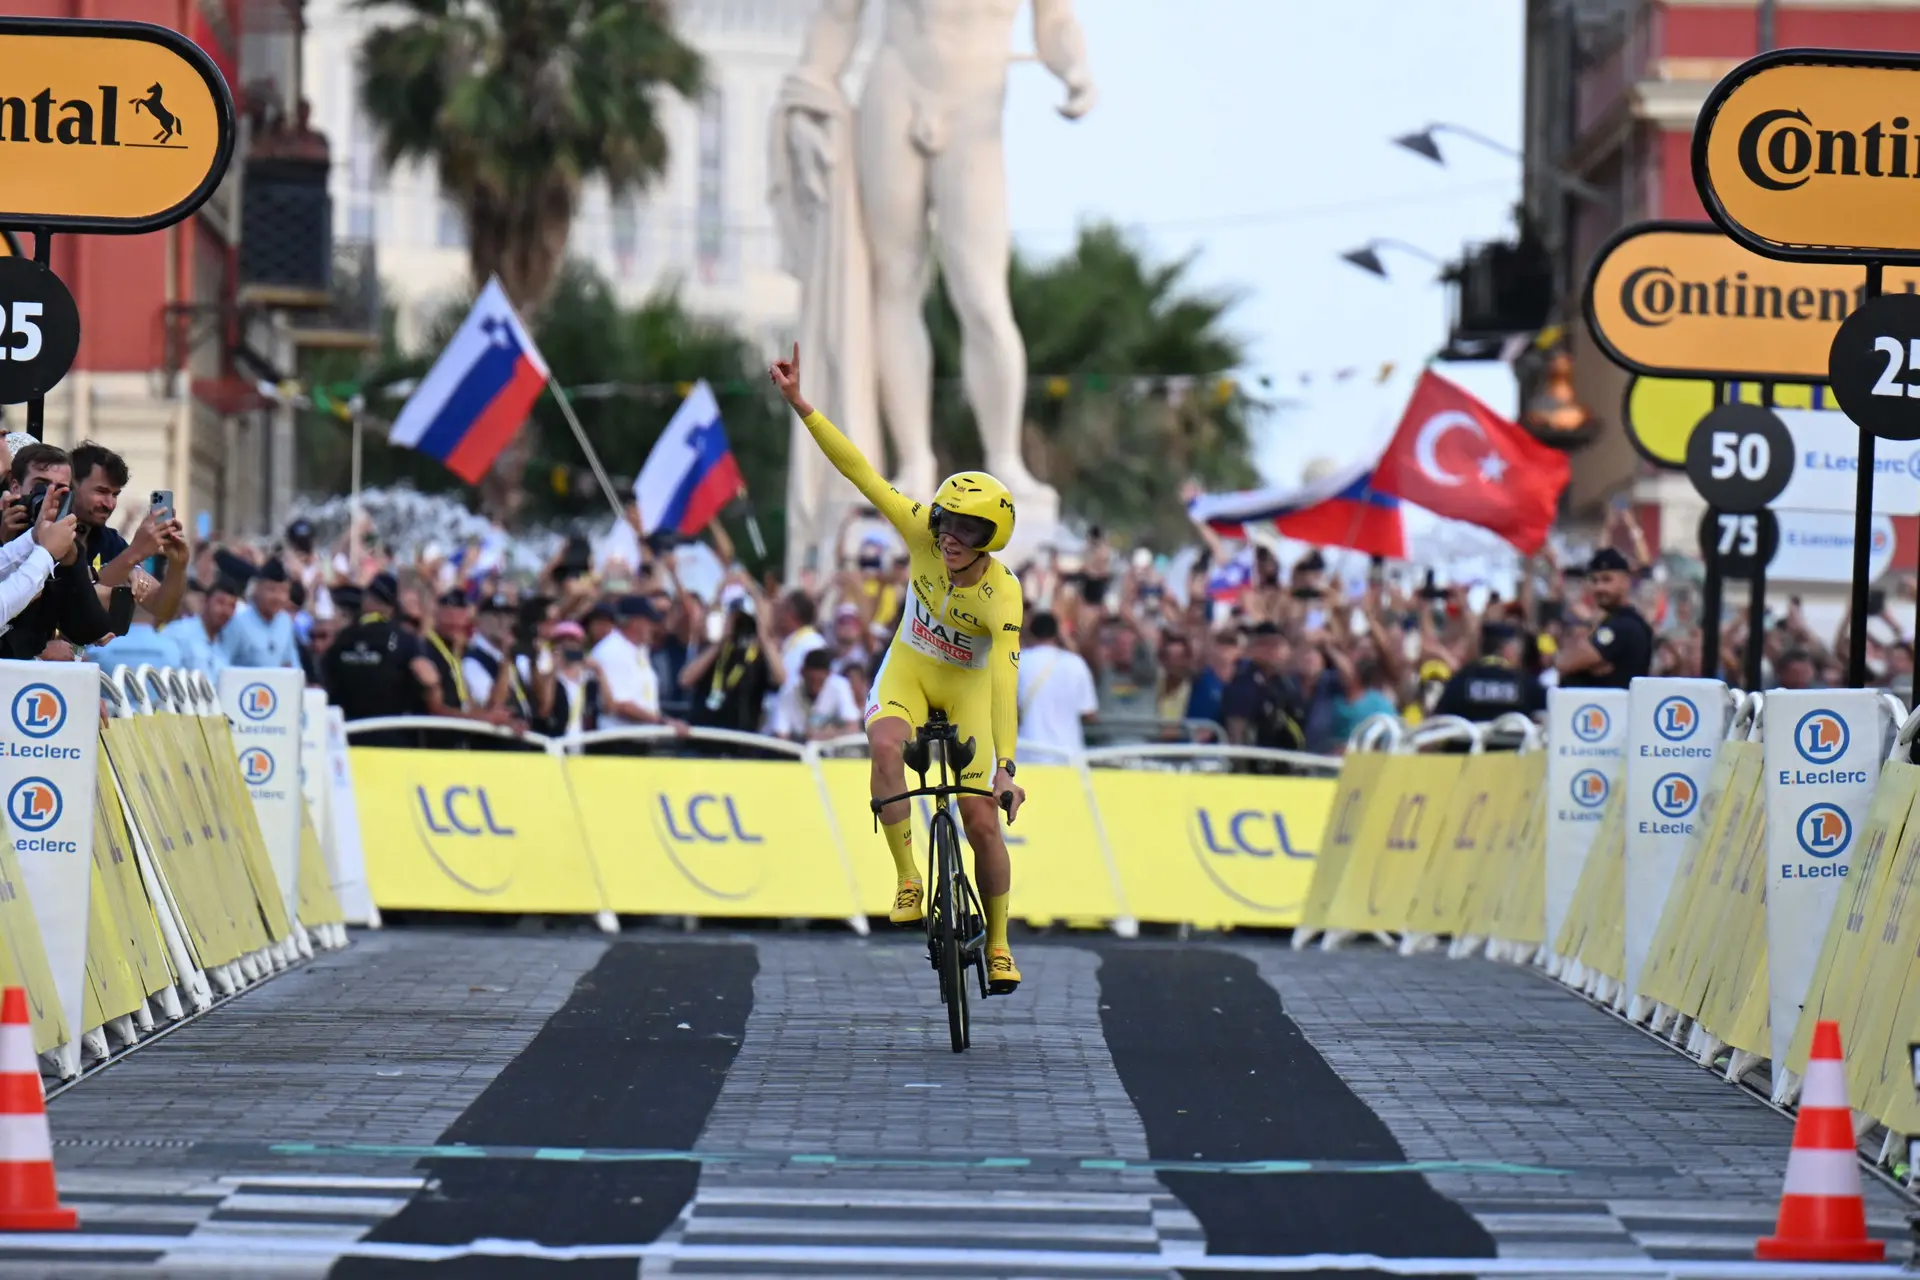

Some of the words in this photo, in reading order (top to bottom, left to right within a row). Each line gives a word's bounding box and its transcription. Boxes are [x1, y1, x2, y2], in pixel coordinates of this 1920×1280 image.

[1738, 107, 1920, 191] Conti
[0, 301, 43, 362] 5
[1711, 431, 1770, 480] 50
[1805, 452, 1905, 473] E.Lecerc
[1717, 514, 1759, 556] 75
[916, 599, 972, 650] UAE
[953, 608, 982, 628] LCL
[913, 621, 971, 660] Emirates
[1640, 744, 1711, 758] E.Leclerc
[961, 771, 983, 780] ntini
[1779, 770, 1867, 785] E.Leclerc
[416, 785, 515, 836] LCL
[657, 793, 765, 844] LCL
[1639, 821, 1694, 834] E.Lecle
[1197, 807, 1318, 859] LCL
[1782, 863, 1849, 879] E.Lecle
